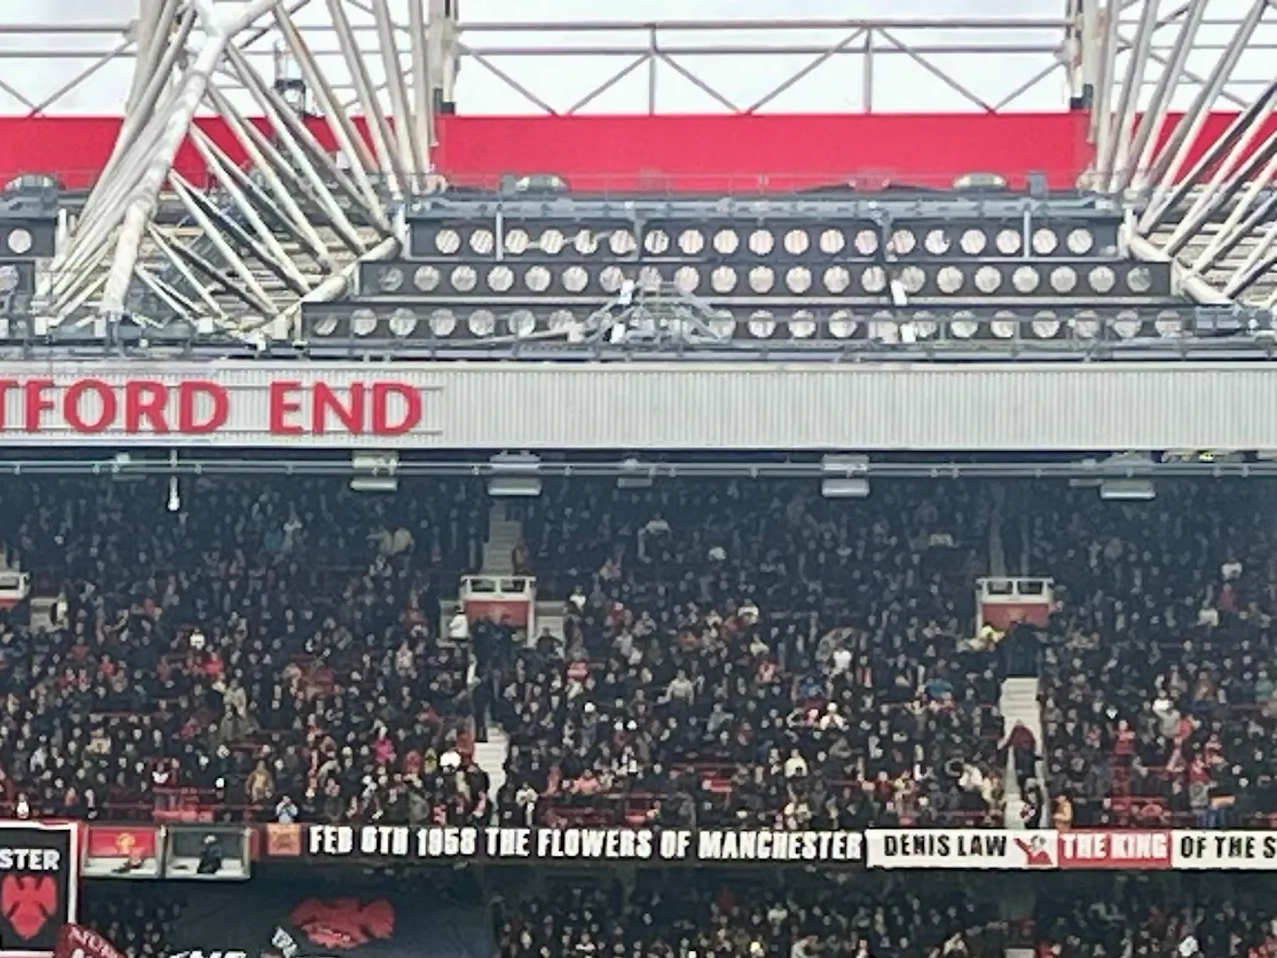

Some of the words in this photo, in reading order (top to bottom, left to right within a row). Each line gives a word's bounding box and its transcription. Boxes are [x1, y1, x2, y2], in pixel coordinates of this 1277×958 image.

[269, 380, 423, 437] END
[417, 826, 477, 856] 1958
[485, 827, 530, 857] THE
[537, 828, 652, 858] FLOWERS
[660, 829, 691, 858] OF
[698, 830, 863, 860] MANCHESTER
[883, 834, 952, 857] DENIS
[957, 834, 1008, 857] LAW
[1061, 833, 1107, 859] THE
[1110, 832, 1169, 860] KING
[1181, 836, 1207, 858] OF
[1214, 836, 1255, 858] THE
